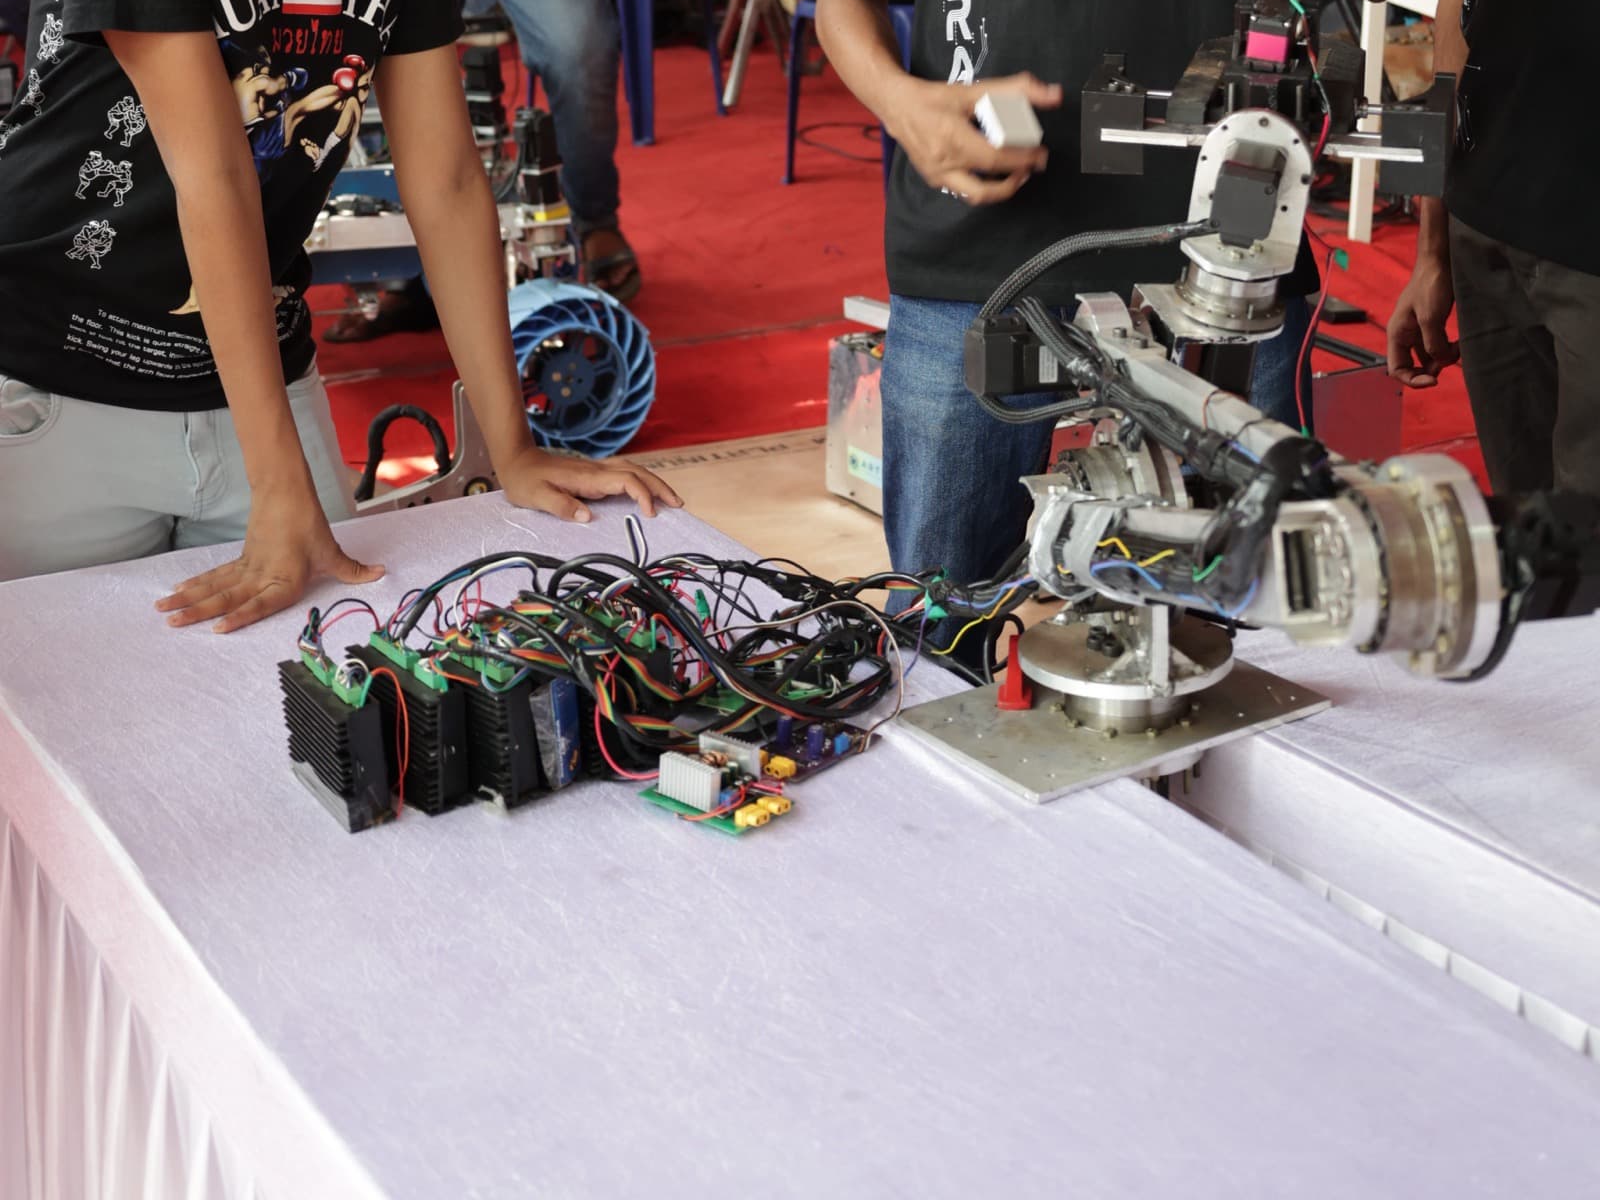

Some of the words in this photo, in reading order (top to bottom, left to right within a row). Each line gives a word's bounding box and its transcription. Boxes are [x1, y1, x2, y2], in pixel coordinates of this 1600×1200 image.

[271, 18, 344, 55] มวยไทย
[72, 314, 85, 324] the
[110, 325, 124, 337] This
[131, 321, 166, 336] maximum
